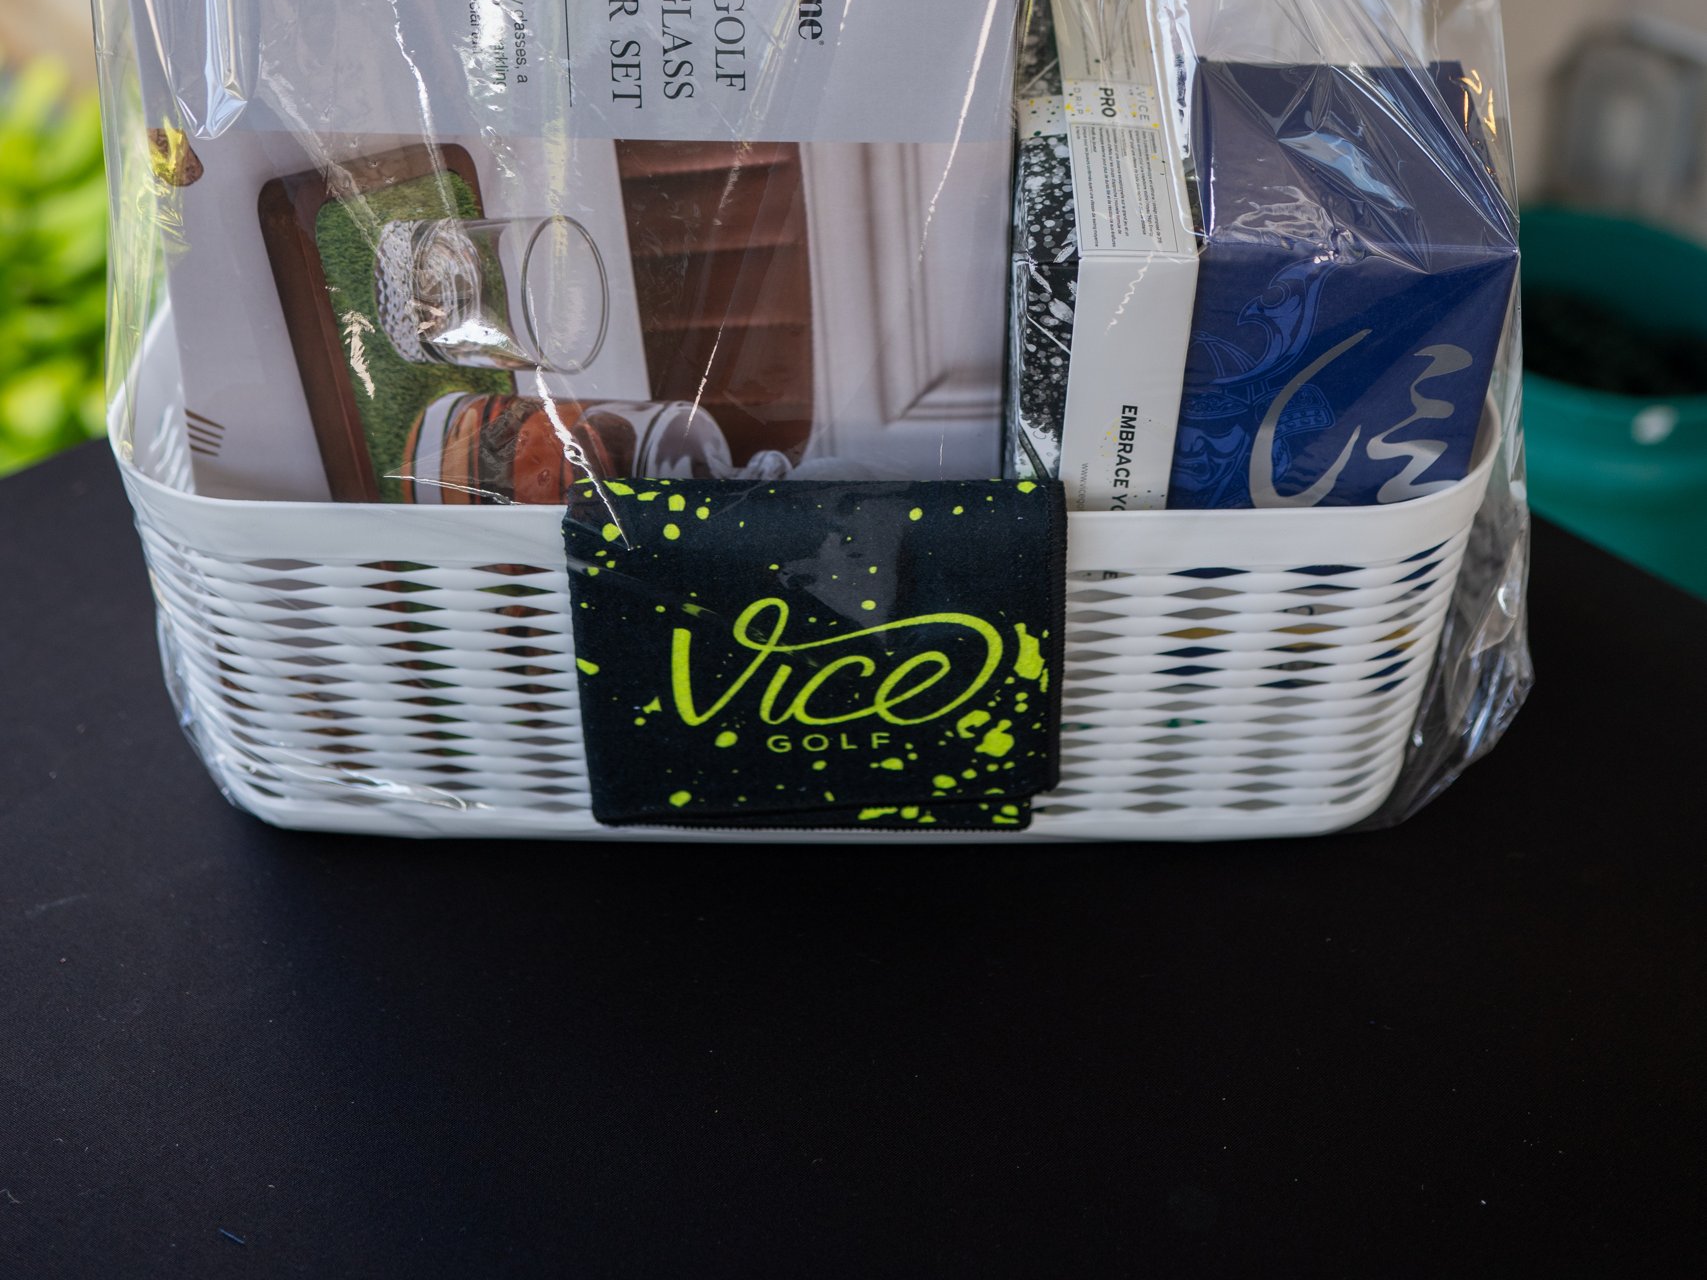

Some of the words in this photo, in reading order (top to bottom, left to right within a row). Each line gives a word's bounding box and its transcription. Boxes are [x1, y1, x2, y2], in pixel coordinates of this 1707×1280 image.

[517, 75, 528, 83] a
[610, 39, 643, 110] SET
[1073, 87, 1083, 115] DRIP
[1099, 87, 1116, 118] PRO
[1137, 91, 1150, 121] VICE
[1113, 404, 1138, 488] EMBRACE
[671, 597, 1003, 726] Vice
[767, 731, 892, 753] GOLF
